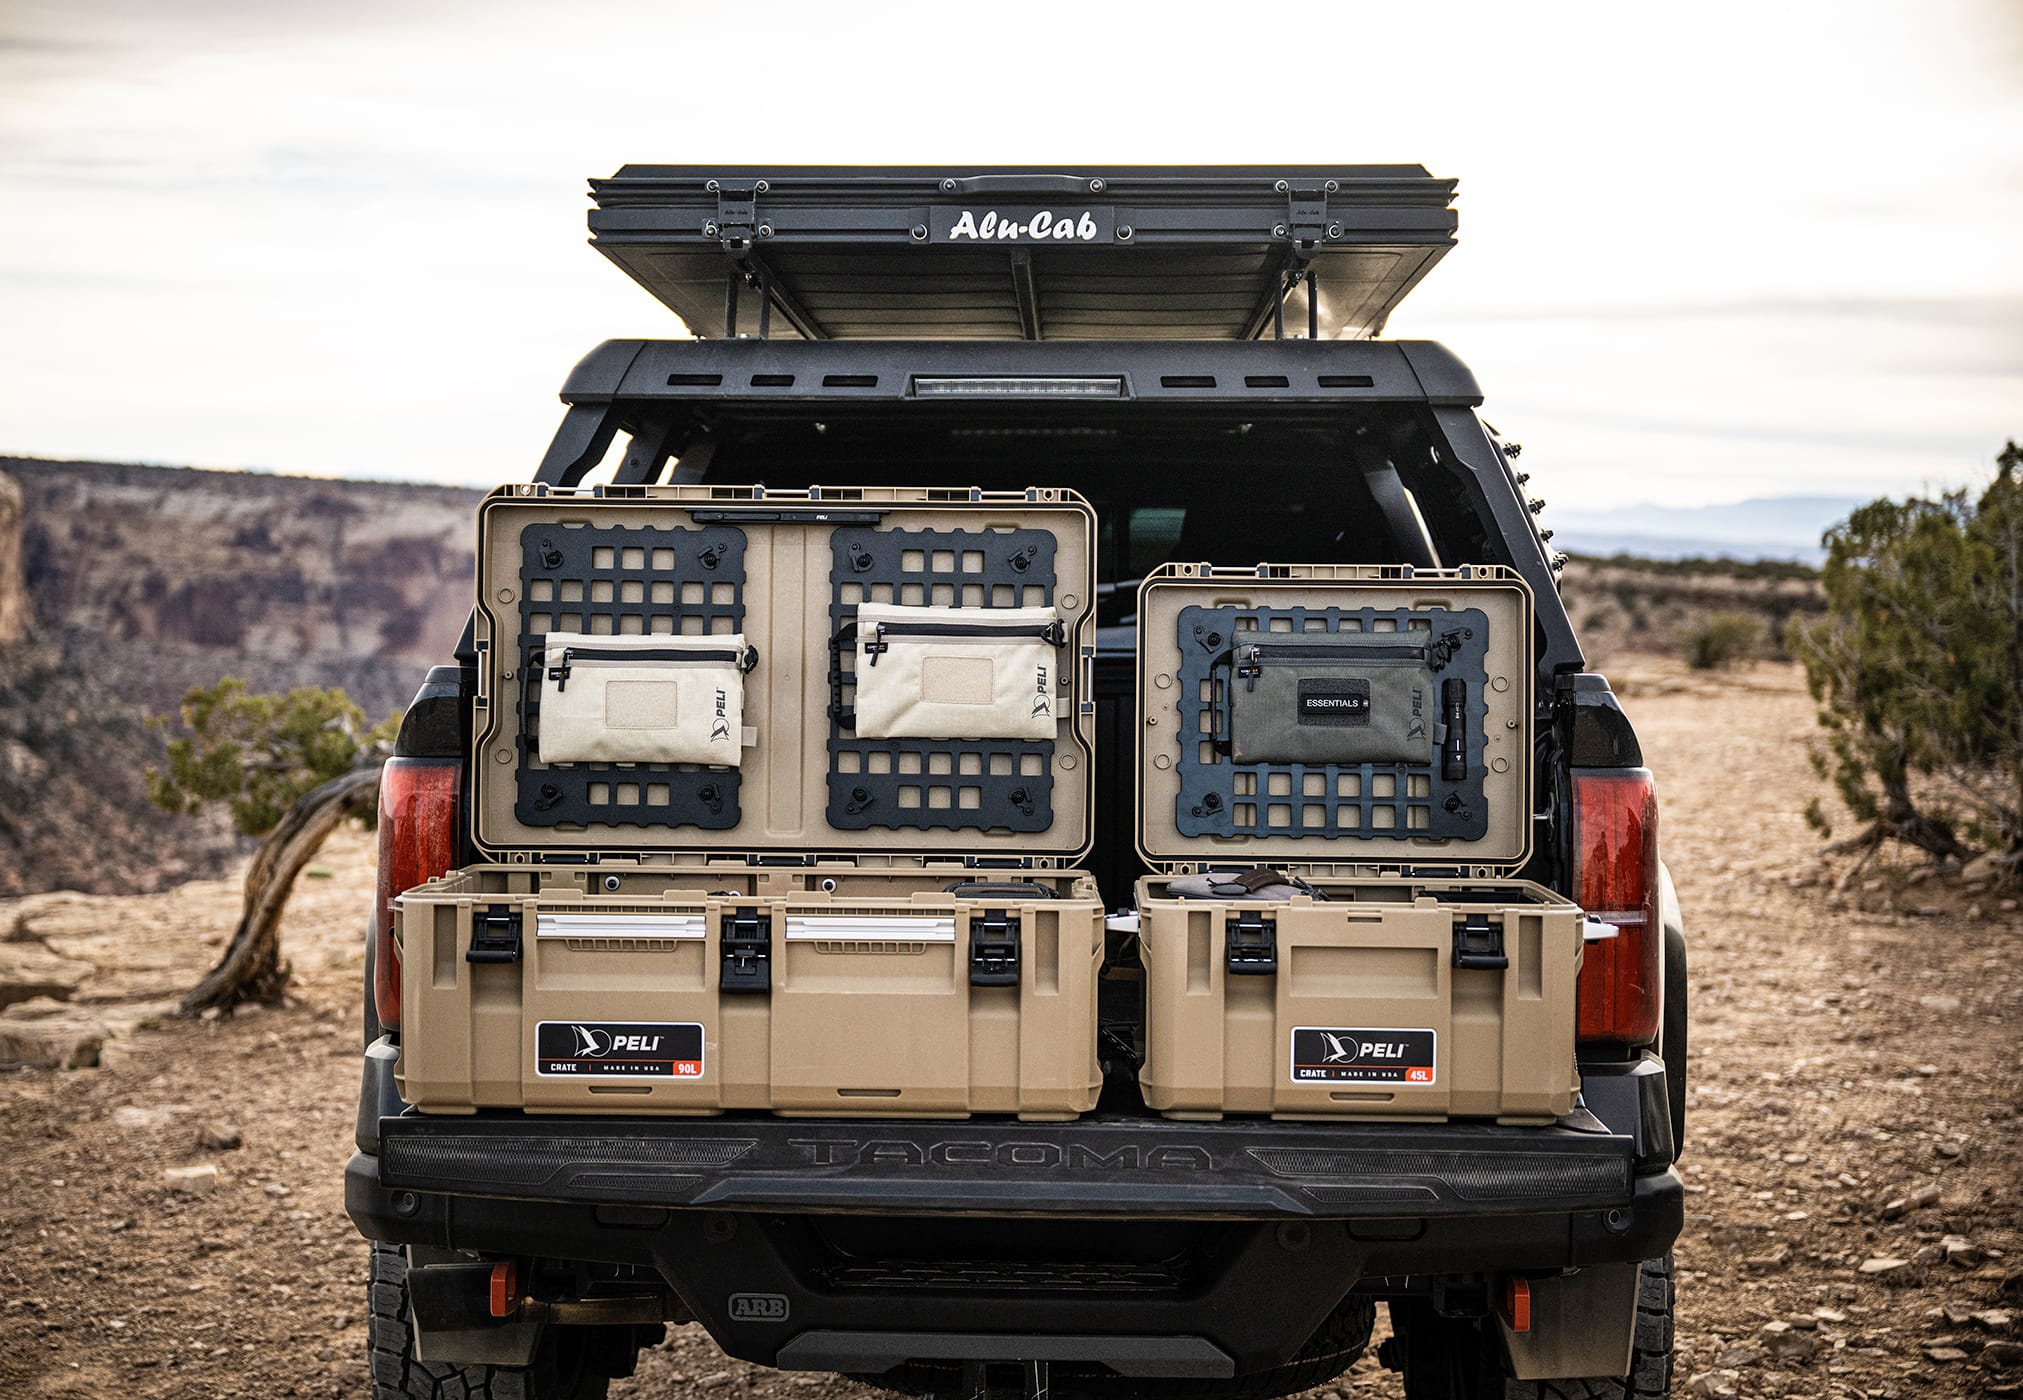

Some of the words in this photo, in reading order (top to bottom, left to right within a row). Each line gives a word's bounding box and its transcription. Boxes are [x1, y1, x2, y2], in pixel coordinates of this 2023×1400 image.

[950, 210, 1097, 240] Alu-Cab
[1037, 665, 1047, 694] PELI
[716, 689, 726, 717] PELI
[1306, 699, 1359, 708] ESSENTIALS
[1412, 688, 1423, 717] PELI
[612, 1035, 660, 1051] PELI
[1359, 1042, 1405, 1058] PELI
[550, 1063, 577, 1072] CRATE
[678, 1063, 697, 1074] 90L
[1300, 1069, 1327, 1078] CRATE
[1410, 1070, 1428, 1080] 45L
[787, 1139, 1213, 1169] TACOMA
[735, 1298, 785, 1316] ARB
